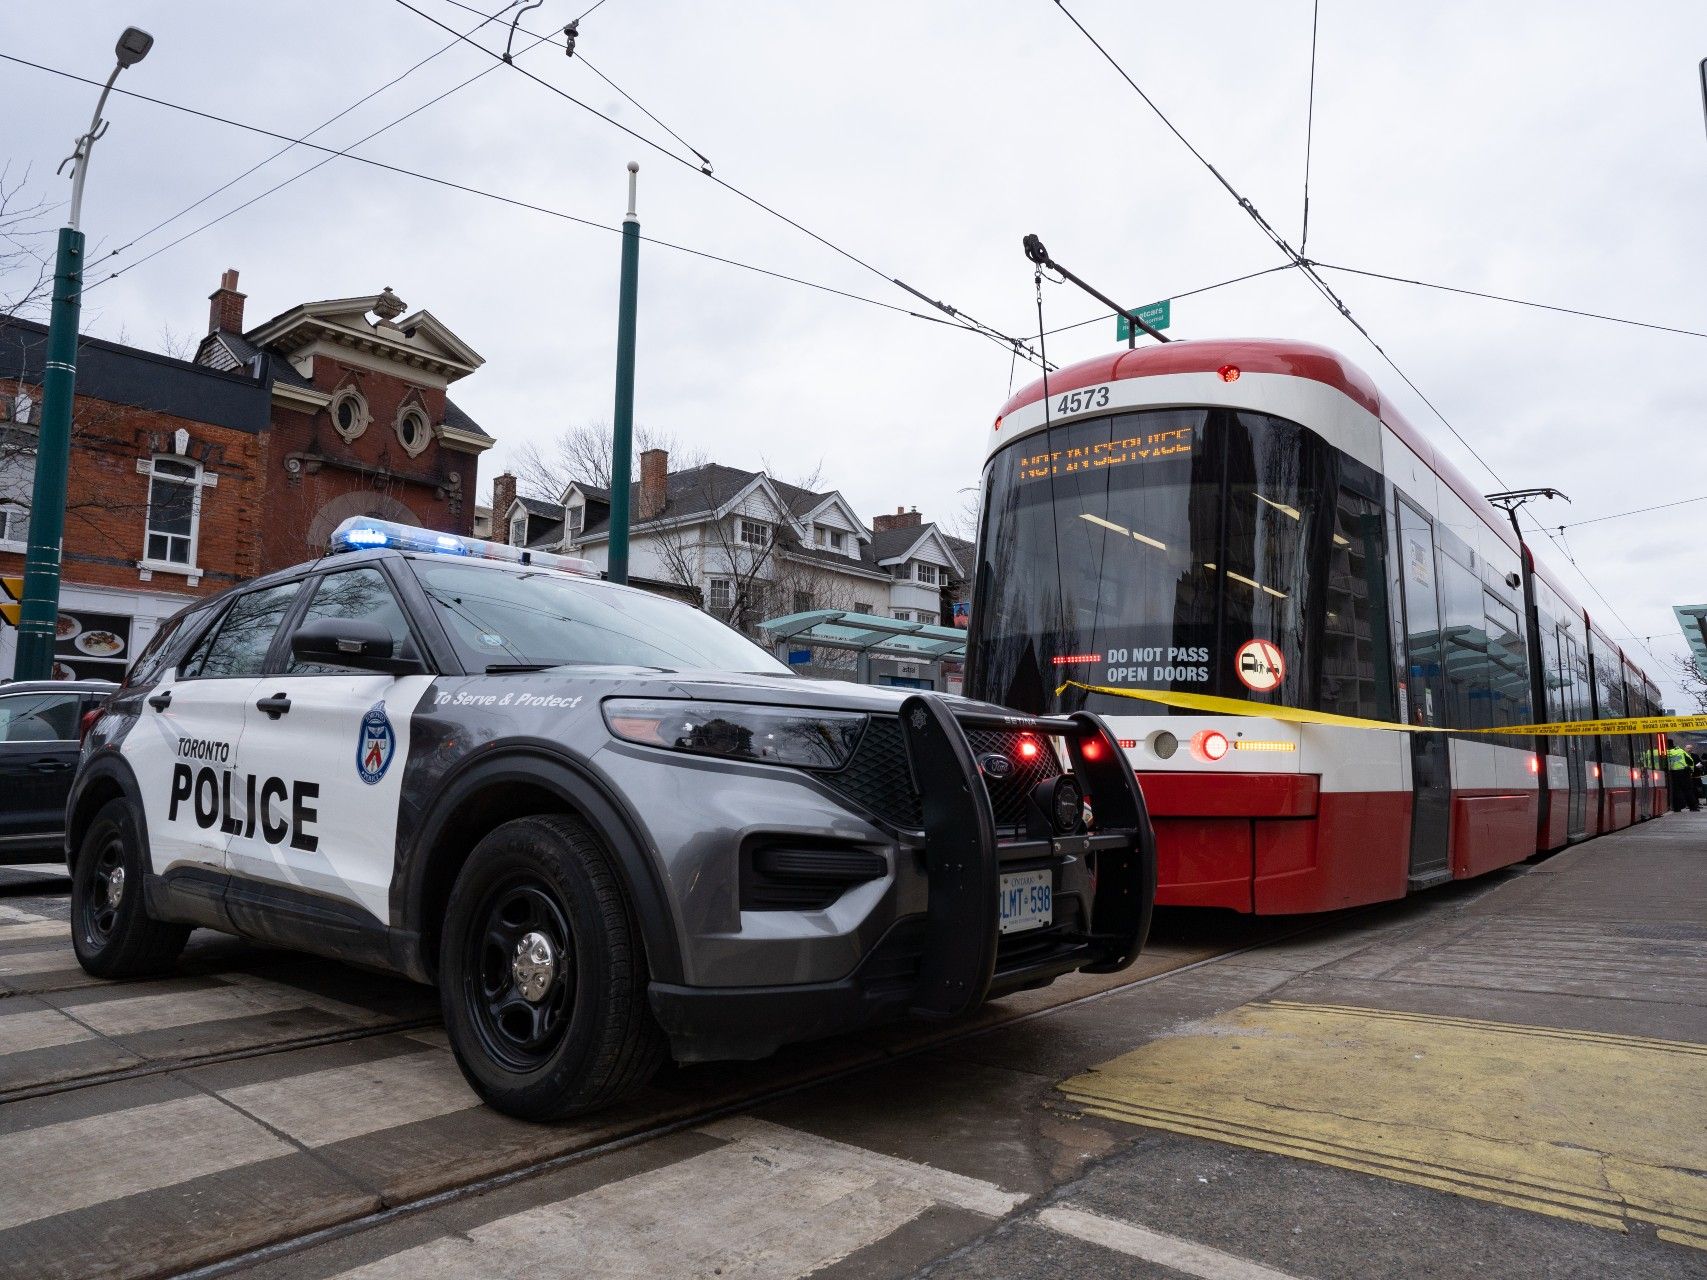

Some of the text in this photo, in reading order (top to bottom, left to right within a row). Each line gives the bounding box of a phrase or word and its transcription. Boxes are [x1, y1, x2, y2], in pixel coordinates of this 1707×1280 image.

[1058, 387, 1110, 414] 4573
[1020, 428, 1191, 479] NOT IN SERVICE
[1107, 647, 1209, 664] DO NOT PASS
[1107, 666, 1209, 682] OPEN DOORS
[433, 691, 583, 708] To Serve & Protect
[1004, 716, 1037, 726] SETINA
[177, 737, 230, 763] TORONTO
[168, 763, 320, 853] POLICE
[1031, 885, 1050, 913] 598
